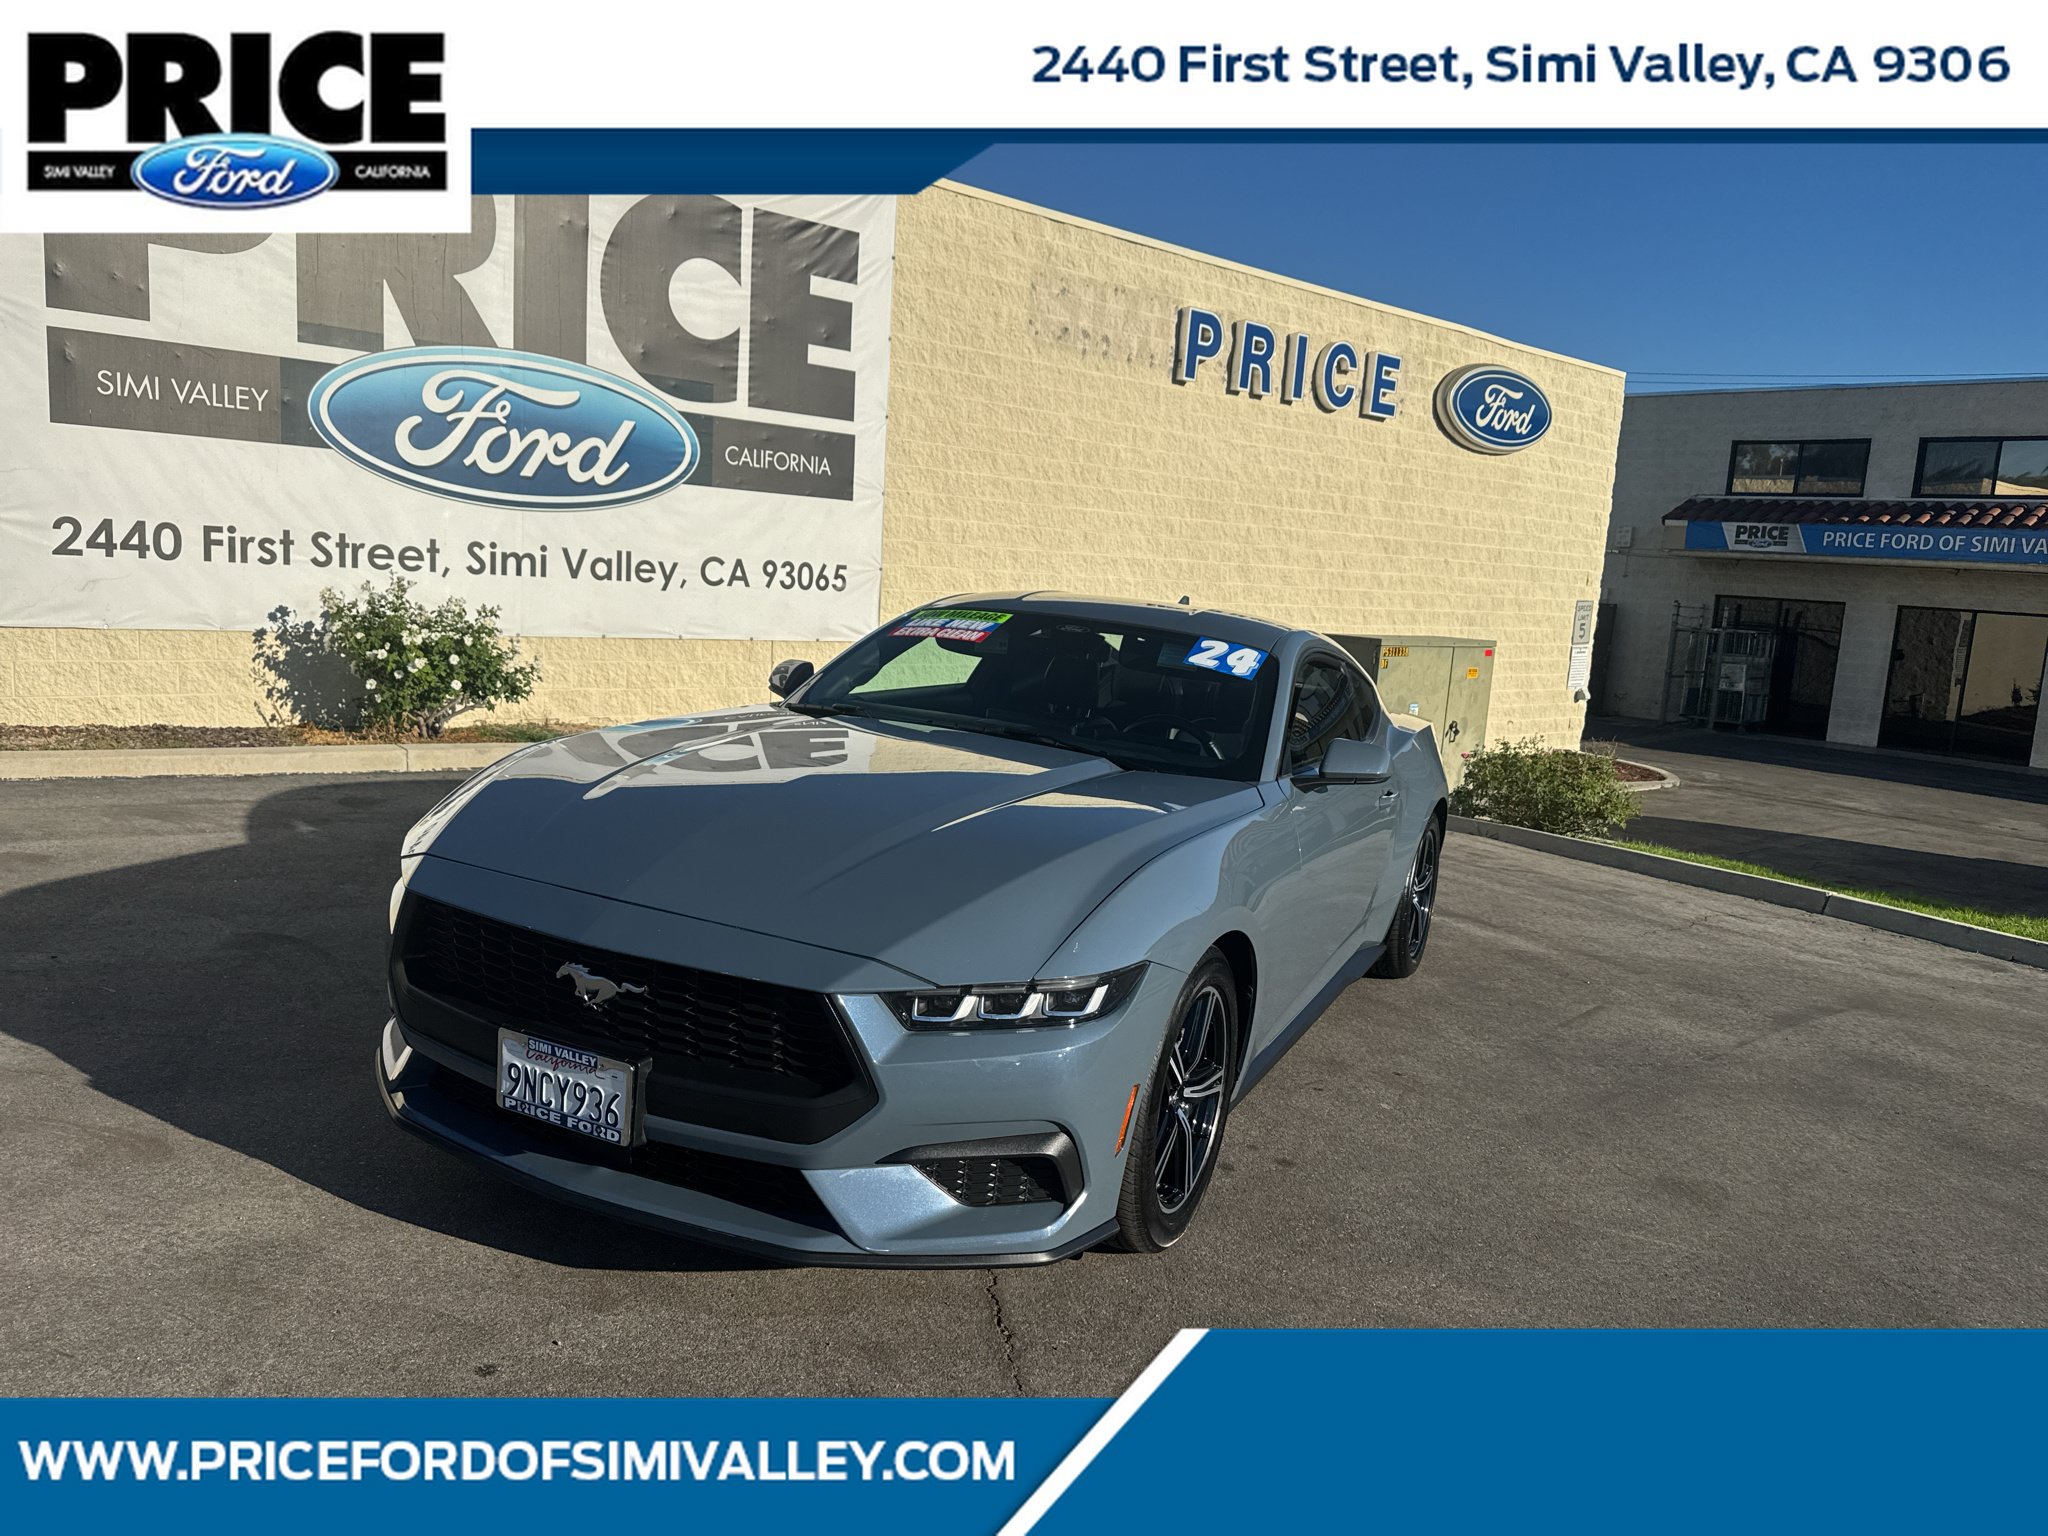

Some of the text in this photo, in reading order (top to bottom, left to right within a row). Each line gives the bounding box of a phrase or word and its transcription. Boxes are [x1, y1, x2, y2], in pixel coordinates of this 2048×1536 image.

[1176, 305, 1402, 418] PRICE
[96, 369, 269, 412] SIMI VALLEY
[395, 369, 637, 486] Ford
[1475, 384, 1536, 436] Ford
[724, 445, 832, 477] CALIFORNIA
[1735, 525, 1789, 540] PRICE
[1823, 531, 2048, 555] PRICE FORD OF SIMI VA
[51, 516, 848, 592] 2440 First Street, Simi Valley, CA 93065
[893, 627, 985, 641] EXTRA CLEAN
[905, 619, 995, 631] LIKE NEW
[1578, 623, 1586, 639] 5
[1188, 640, 1262, 676] 24
[529, 1039, 597, 1067] SIMI VALLEY
[507, 1062, 621, 1128] 9NCY936
[504, 1097, 620, 1143] PRICE FORD
